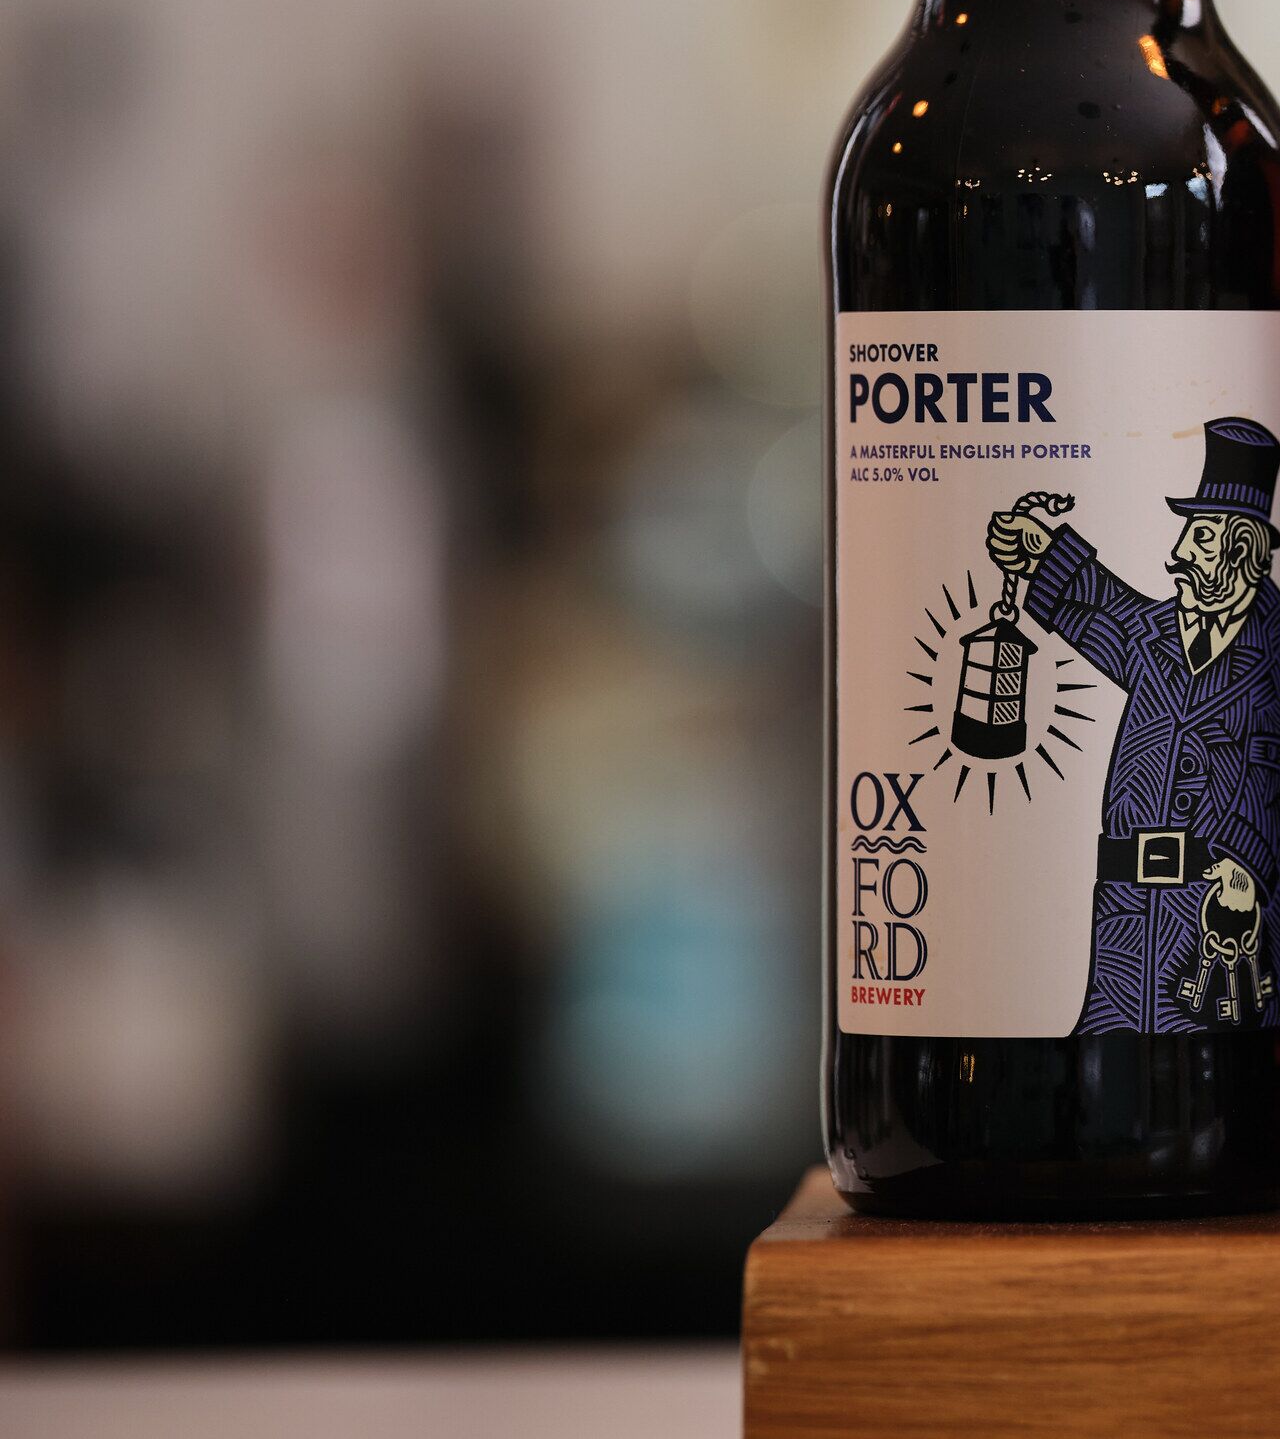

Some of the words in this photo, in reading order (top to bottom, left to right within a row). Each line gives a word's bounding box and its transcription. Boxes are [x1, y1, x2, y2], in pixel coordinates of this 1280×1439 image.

[850, 344, 938, 362] SHOTOVER
[850, 373, 1056, 424] PORTER
[860, 445, 935, 459] MASTERFUL
[940, 445, 1014, 459] ENGLISH
[1021, 445, 1091, 458] PORTER
[851, 468, 868, 481] ALC
[873, 468, 903, 481] 5.0%
[908, 467, 939, 481] VOL
[852, 986, 925, 1006] BREWERY
